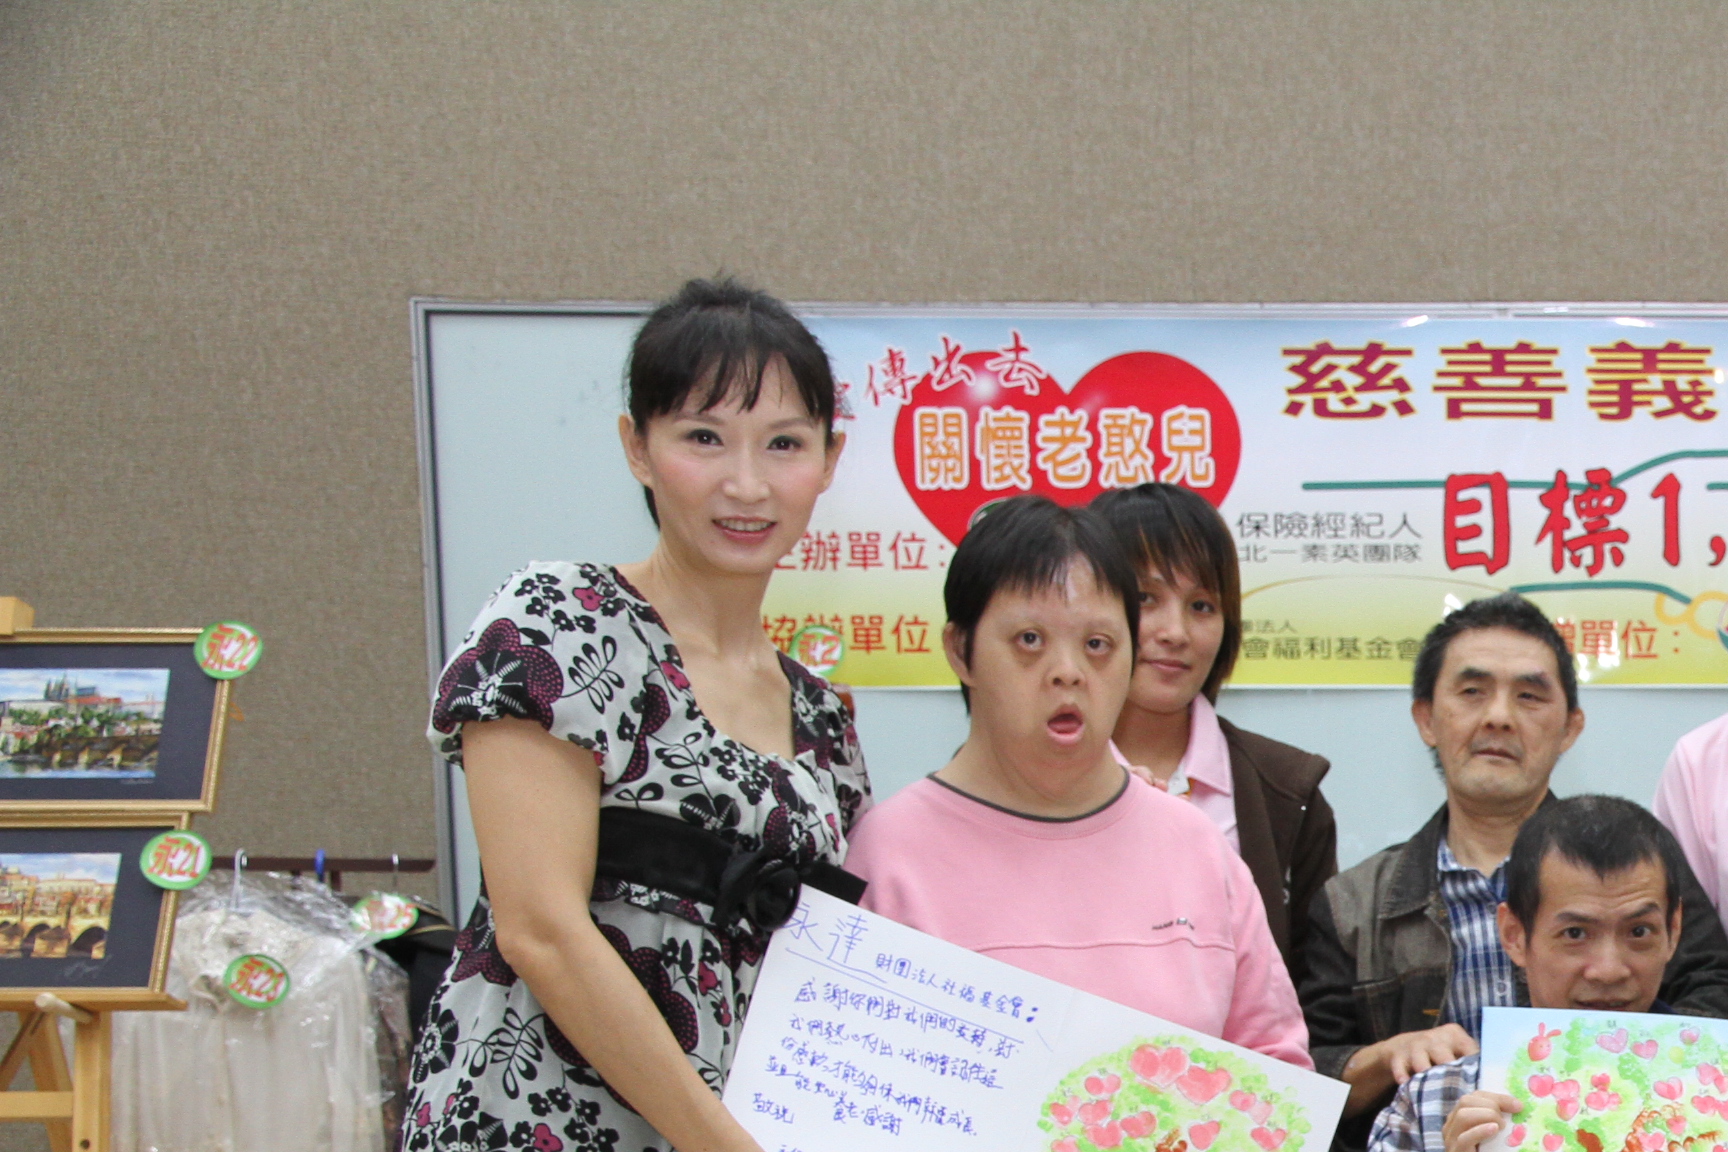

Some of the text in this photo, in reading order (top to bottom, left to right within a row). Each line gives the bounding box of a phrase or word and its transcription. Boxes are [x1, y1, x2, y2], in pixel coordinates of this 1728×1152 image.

[914, 406, 1215, 490] 關懷老憨兒
[1236, 512, 1423, 540] 保險經紀人
[1239, 543, 1423, 563] 北一素英團隊
